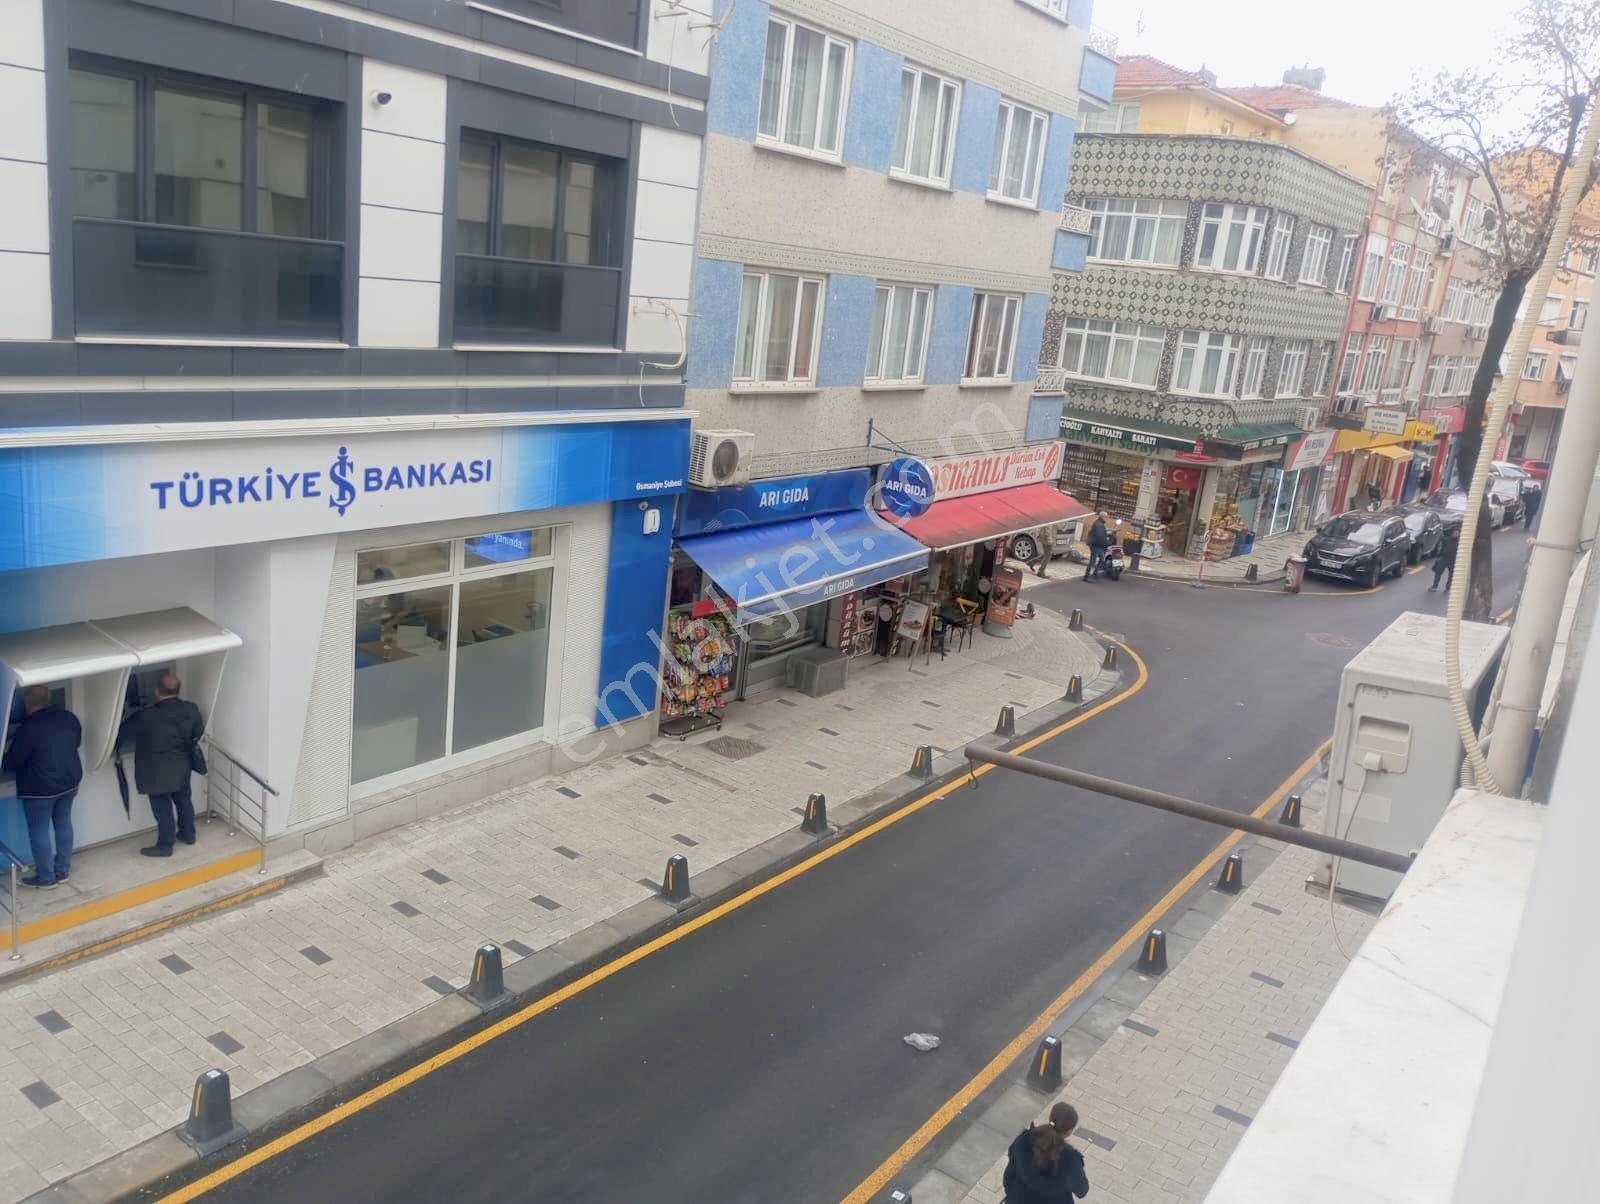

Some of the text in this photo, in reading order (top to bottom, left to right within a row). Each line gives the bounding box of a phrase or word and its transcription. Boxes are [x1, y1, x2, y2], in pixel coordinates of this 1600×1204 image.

[150, 467, 321, 510] TÜRKİYE
[364, 459, 492, 492] BANKASI
[636, 479, 683, 491] Osmaniye Şubesi
[886, 481, 927, 498] ARI GIDA
[759, 487, 809, 508] ARI GIDA
[823, 578, 855, 597] ARI GIDA
